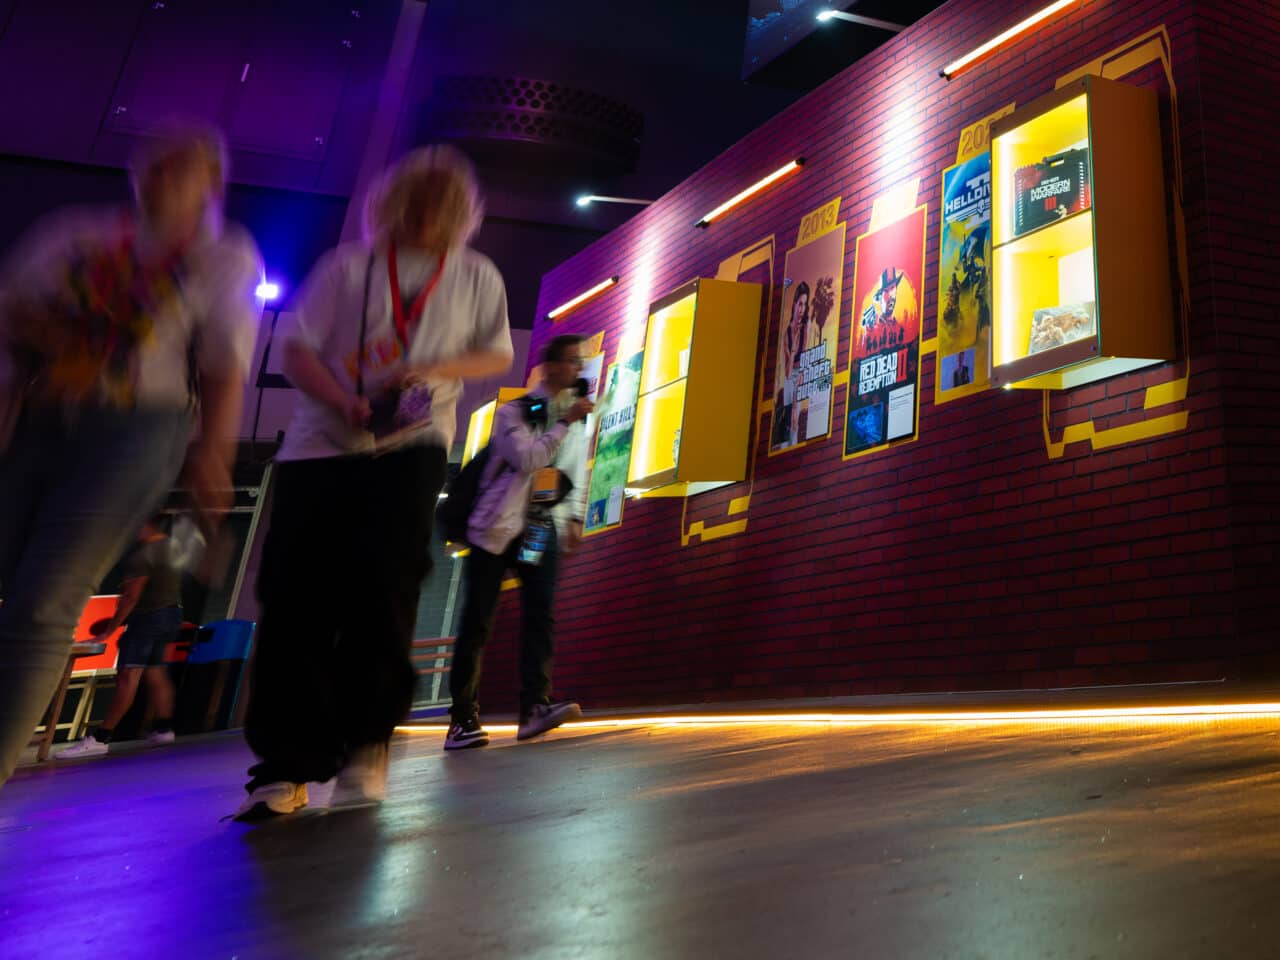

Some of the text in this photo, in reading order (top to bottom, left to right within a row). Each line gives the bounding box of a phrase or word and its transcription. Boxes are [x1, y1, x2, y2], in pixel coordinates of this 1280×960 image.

[860, 360, 876, 381] RED
[876, 352, 898, 377] DEAD
[858, 371, 897, 396] REDEMPTION
